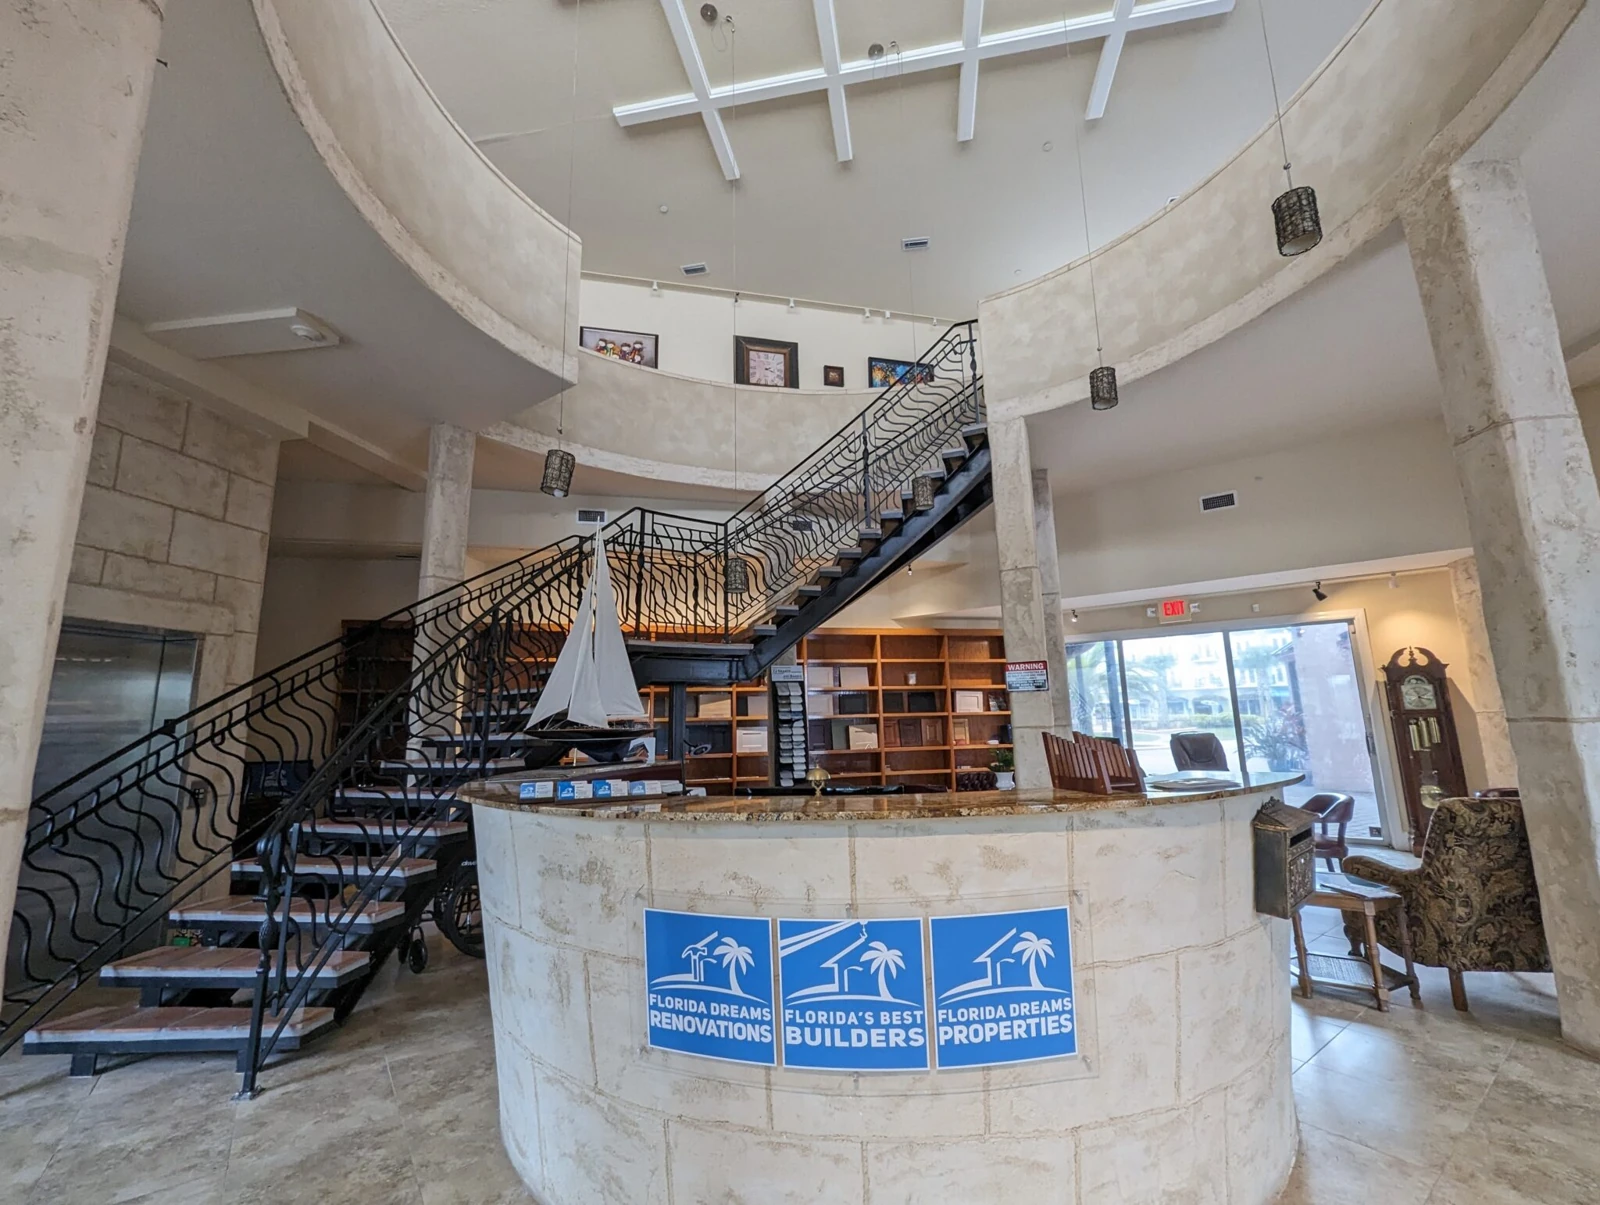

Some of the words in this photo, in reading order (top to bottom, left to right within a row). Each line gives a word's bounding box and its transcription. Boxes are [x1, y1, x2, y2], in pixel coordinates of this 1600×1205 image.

[1163, 600, 1184, 616] EXIT
[1007, 662, 1044, 671] WARNING
[650, 994, 707, 1014] FLORIDA
[711, 1003, 772, 1021] DREAMS
[785, 1009, 874, 1025] FLORIDA'S
[880, 1010, 923, 1025] BEST
[938, 1005, 1006, 1023] FLORIDA
[1010, 997, 1072, 1017] DREAMS
[650, 1009, 773, 1043] RENOVATIONS
[785, 1026, 925, 1047] BUILDERS
[939, 1014, 1073, 1046] PROPERTIES
